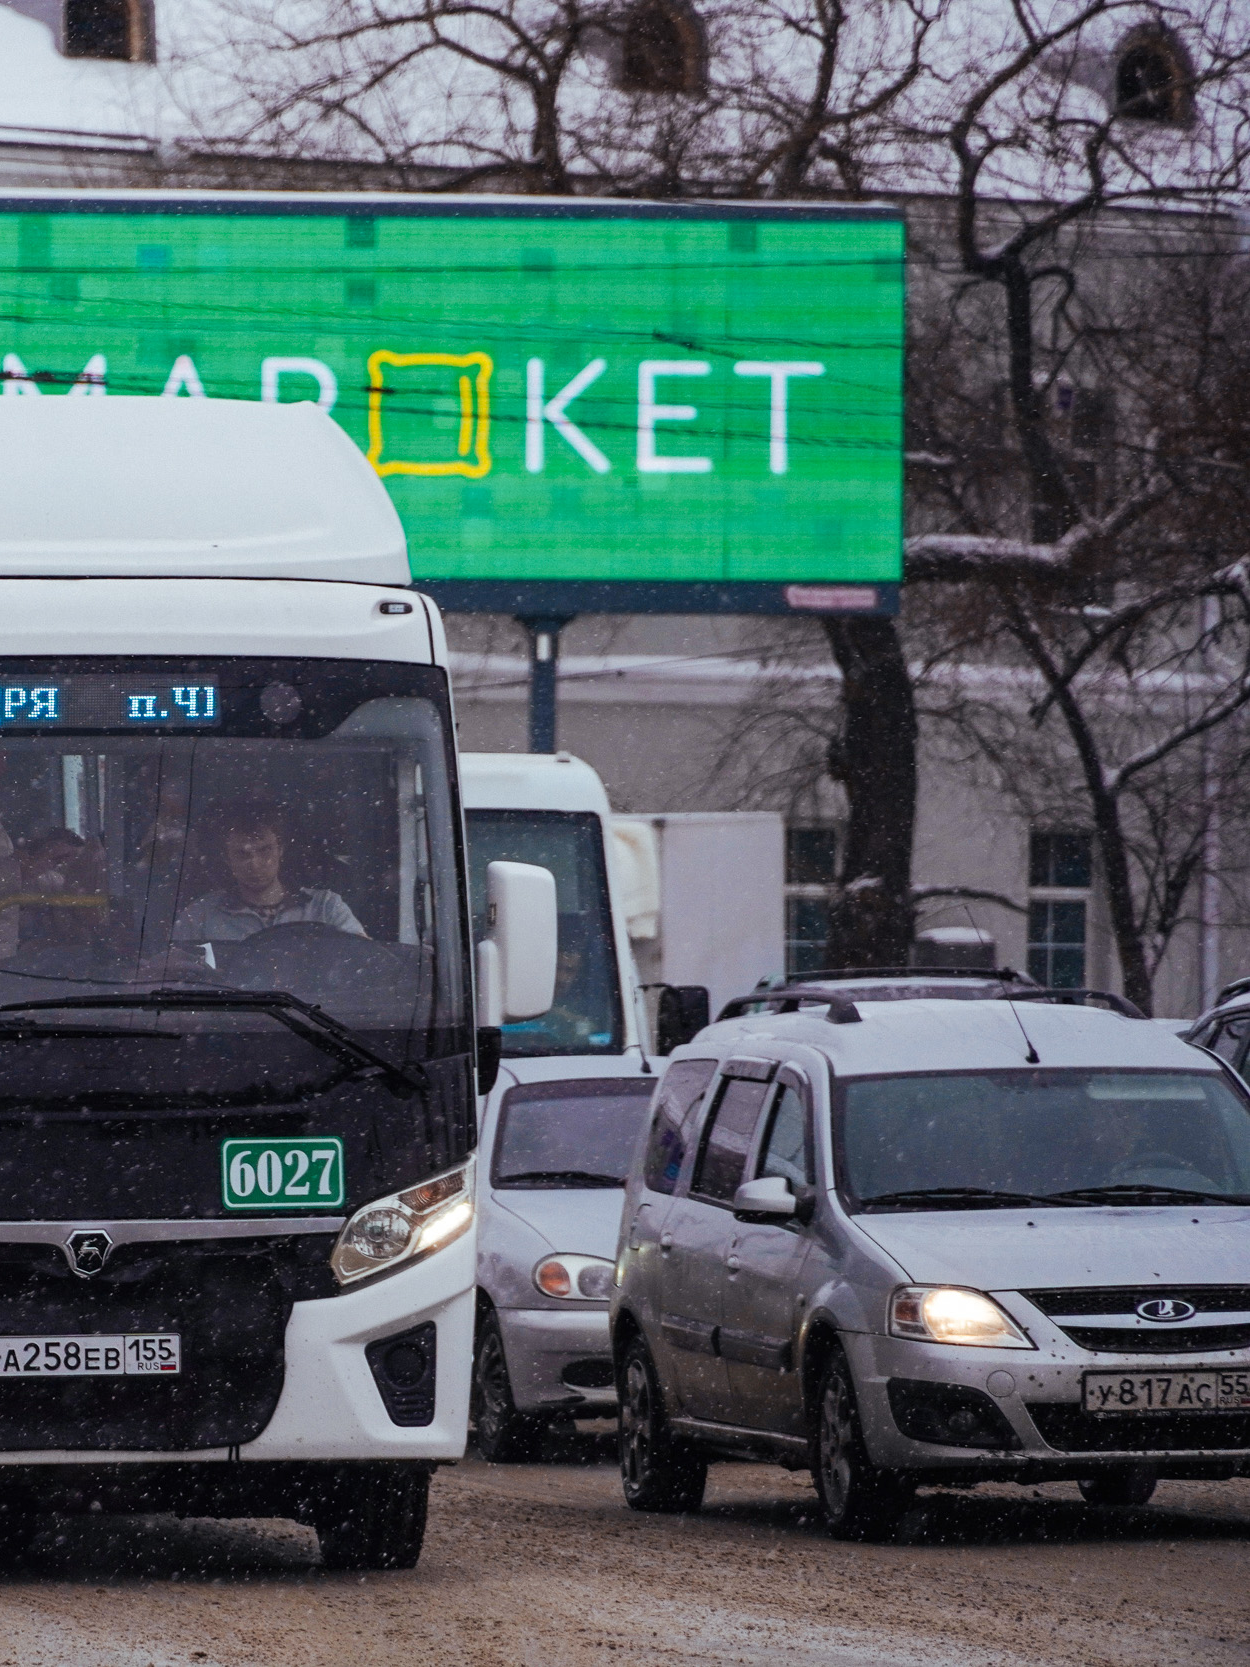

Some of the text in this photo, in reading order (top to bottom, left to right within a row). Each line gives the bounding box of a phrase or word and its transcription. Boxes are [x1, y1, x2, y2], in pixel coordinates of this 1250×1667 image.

[229, 1149, 336, 1197] 6027
[3, 1338, 173, 1372] А258ЕВ 155
[137, 1361, 160, 1371] RUS
[1220, 1374, 1248, 1396] 55
[1219, 1396, 1240, 1404] RUS
